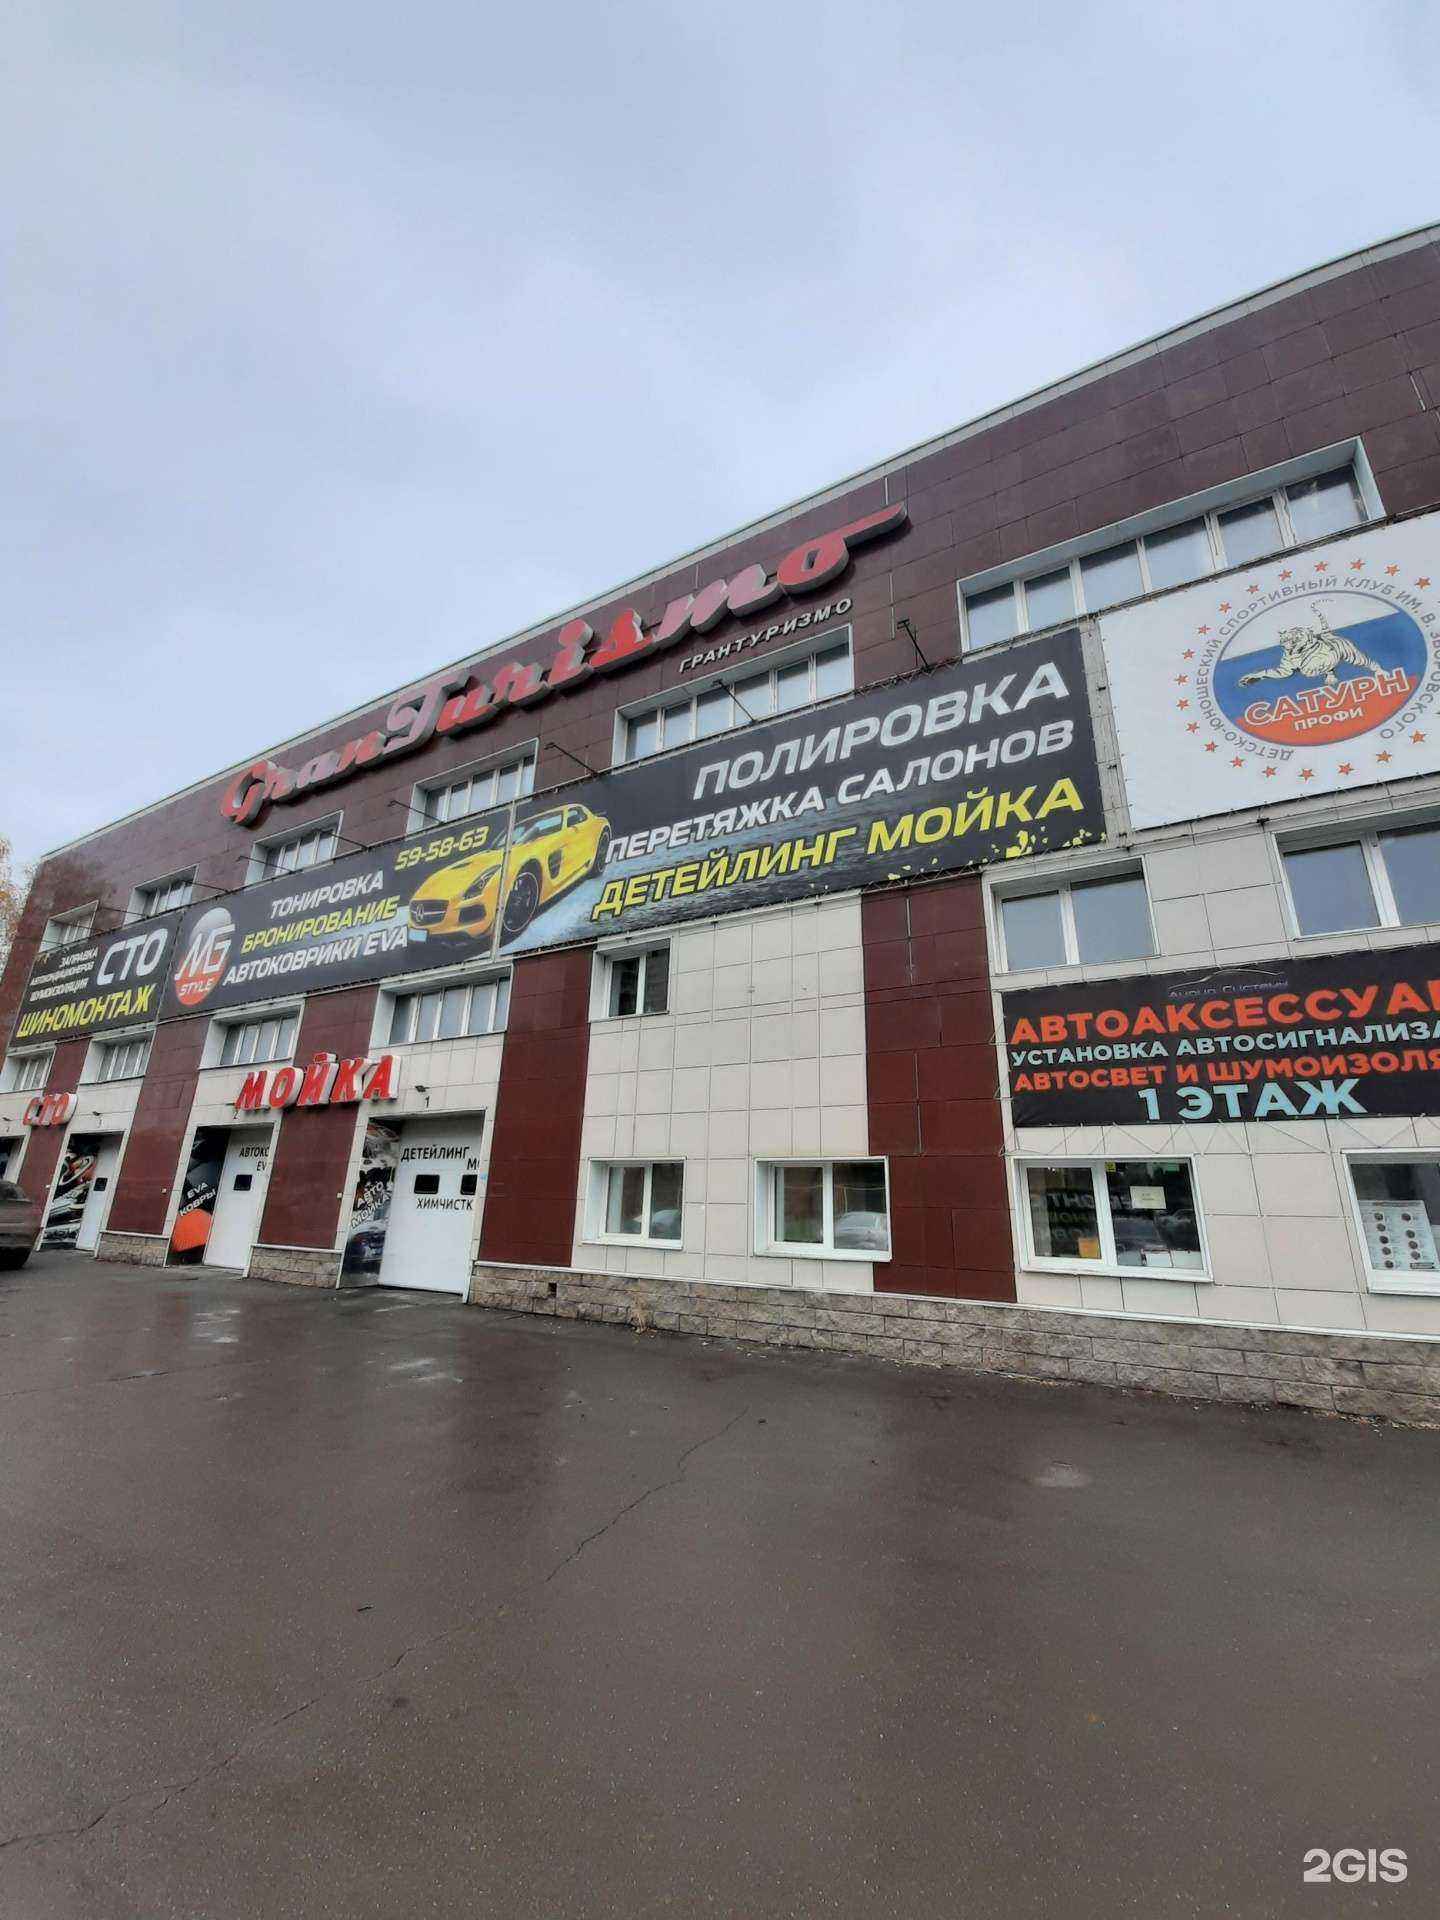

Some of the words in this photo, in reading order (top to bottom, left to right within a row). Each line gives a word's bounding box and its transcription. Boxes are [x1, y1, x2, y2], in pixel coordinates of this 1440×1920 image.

[1219, 574, 1337, 636] СПОРТИВНЫЙ
[1344, 576, 1395, 596] КЛУБ
[1395, 590, 1419, 614] ИМ.
[679, 598, 851, 672] ГРАНТУРИЗМО
[1196, 638, 1294, 761] ДЕТСКО-ЮНОШЕСКИЙ
[1245, 667, 1410, 725] САТУРН
[1295, 707, 1364, 731] ПРОФИ
[693, 662, 1071, 800] ПОЛИРОВКА
[604, 784, 826, 863] ПЕРЕТЯЖКА
[835, 720, 1075, 804] САЛОНОВ
[395, 825, 490, 871] 59-58-63
[592, 826, 857, 920] ДЕТЕЙЛИНГ
[867, 777, 1085, 854] МОЙКА
[270, 870, 384, 919] ТОНИРОВКА
[241, 895, 401, 954] БРОНИРОВАНИЕ
[96, 927, 168, 986] СТО
[222, 938, 362, 986] АВТОКОВРИКИ
[364, 925, 408, 956] EVA
[16, 982, 157, 1038] ШИНОМОНТАЖ
[179, 977, 215, 997] STYLE
[1012, 1042, 1169, 1067] УСТАНОВКА
[1014, 1066, 1166, 1092] АВТОСВЕТ
[1177, 1064, 1199, 1084] И
[234, 1051, 399, 1111] МОЙКА
[1138, 1088, 1160, 1120] 1
[1175, 1078, 1367, 1120] ЭТАЖ
[23, 1092, 77, 1126] СТО
[401, 1144, 470, 1163] ДЕТЕЙЛИНГ
[180, 1189, 216, 1217] КОВРЫ
[187, 1182, 208, 1199] EVA
[416, 1198, 473, 1211] ХИМЧИСТК
